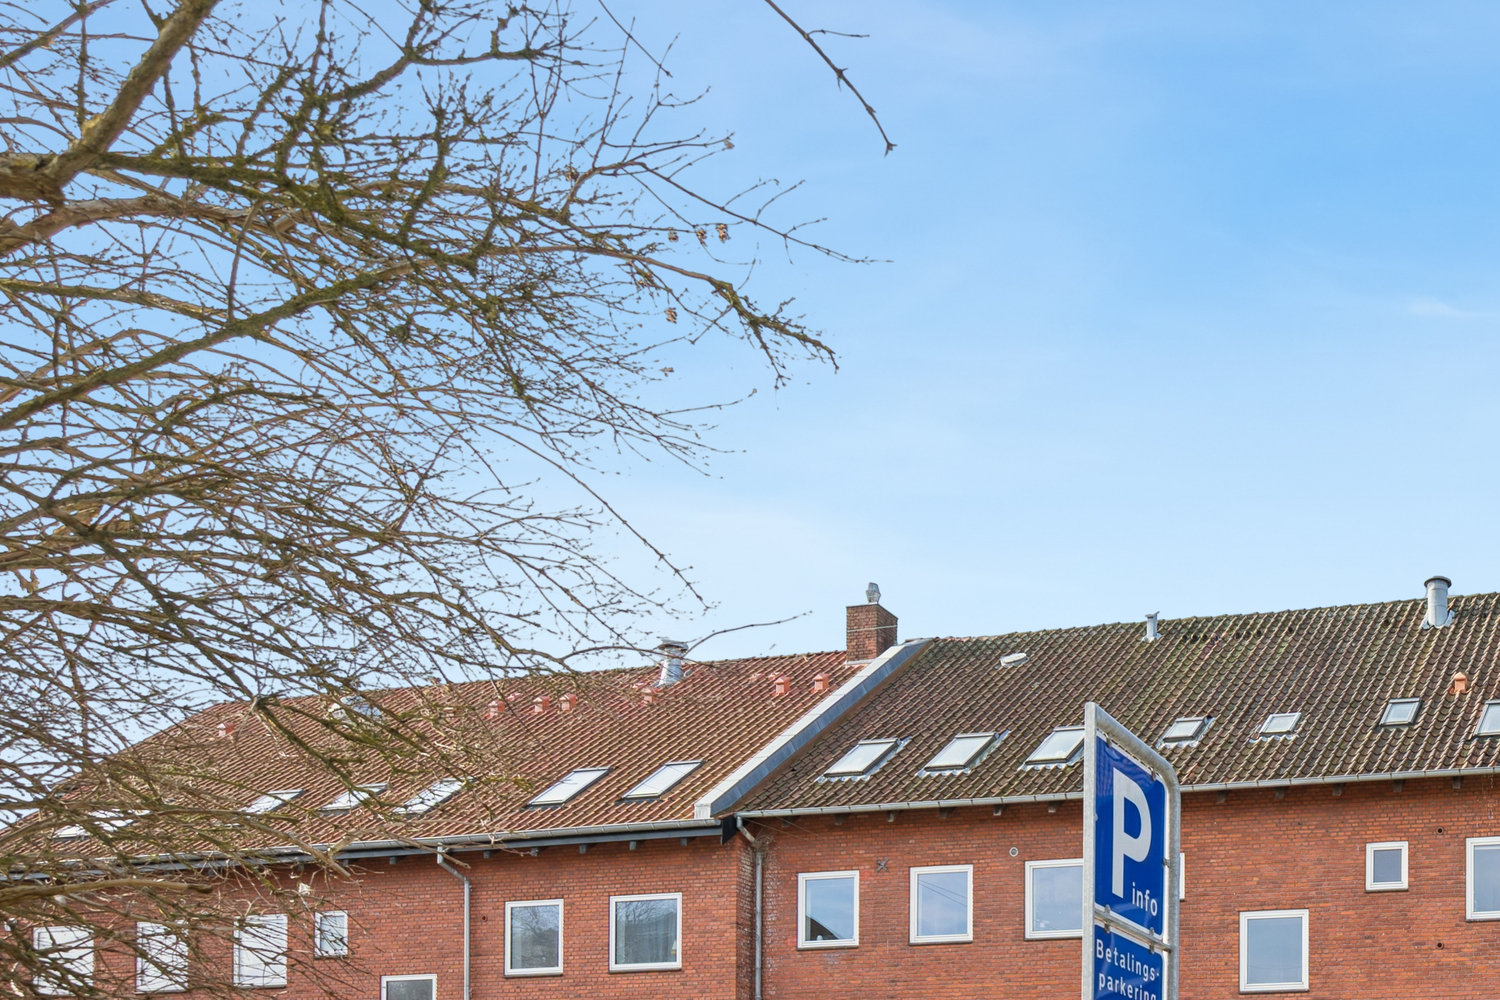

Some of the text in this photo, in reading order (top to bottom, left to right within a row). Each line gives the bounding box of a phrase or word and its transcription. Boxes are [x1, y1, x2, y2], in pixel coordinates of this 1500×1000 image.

[1111, 767, 1152, 899] P
[1131, 881, 1158, 917] info
[1096, 938, 1160, 982] Betalings-
